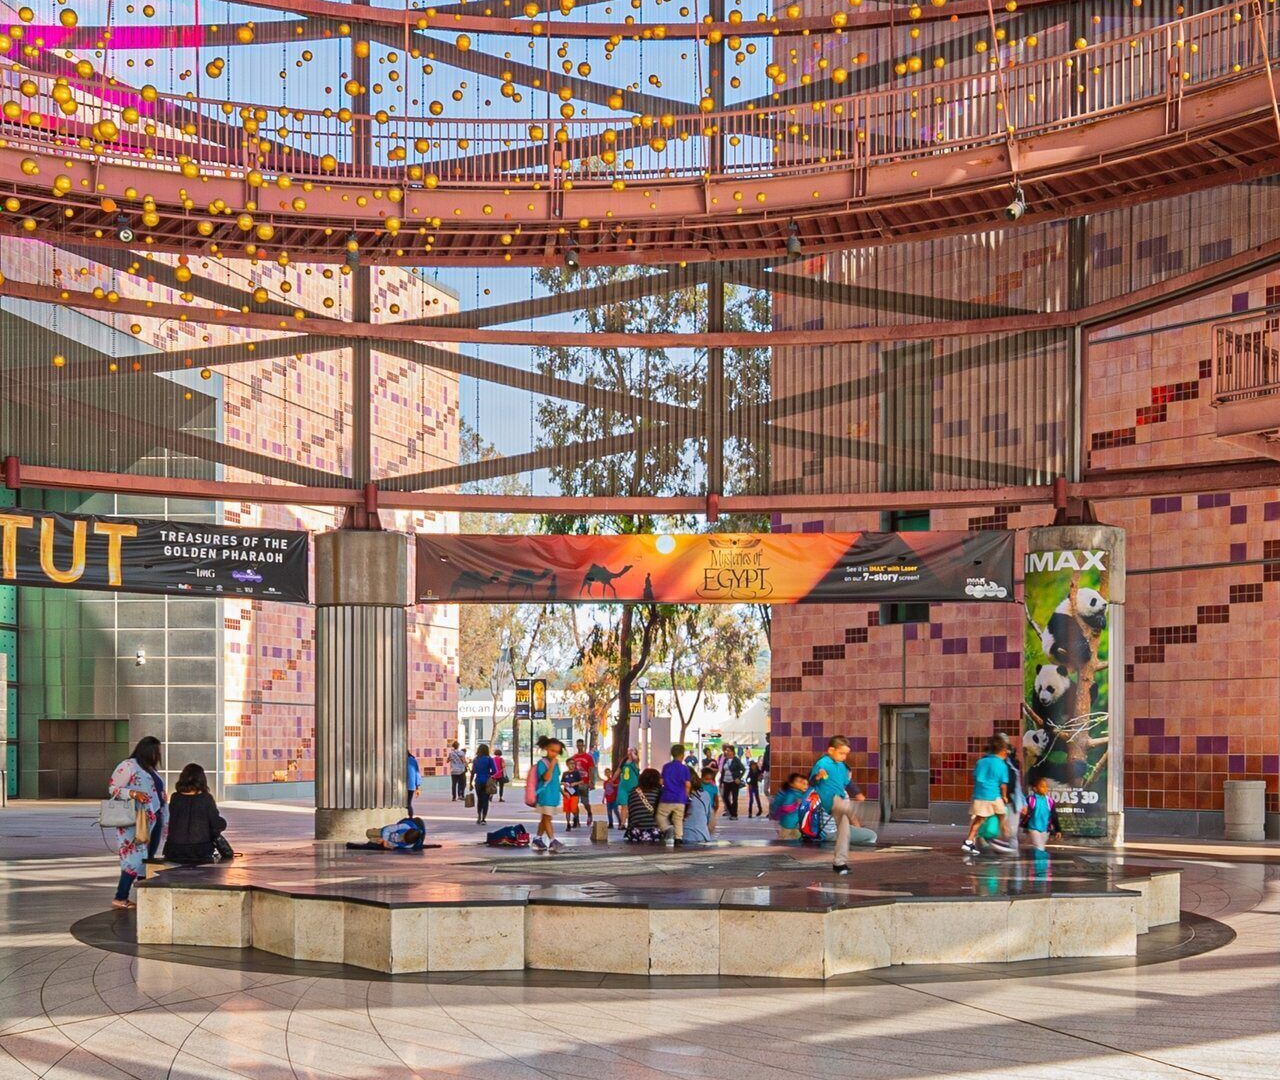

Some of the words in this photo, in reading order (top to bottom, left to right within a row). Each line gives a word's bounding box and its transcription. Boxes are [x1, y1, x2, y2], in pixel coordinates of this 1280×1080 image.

[159, 530, 238, 546] TREASURES
[242, 536, 259, 548] OF
[263, 537, 288, 550] THE
[163, 545, 217, 559] GOLDEN
[222, 549, 283, 563] PHARAOH
[708, 549, 752, 568] Mysteries
[753, 548, 764, 567] of
[1024, 550, 1107, 574] IMAX
[846, 565, 857, 573] See
[862, 572, 899, 583] 7-story
[701, 568, 771, 594] EGYPT
[459, 704, 490, 713] erican
[1048, 791, 1079, 805] DAS
[1080, 791, 1099, 805] 3D
